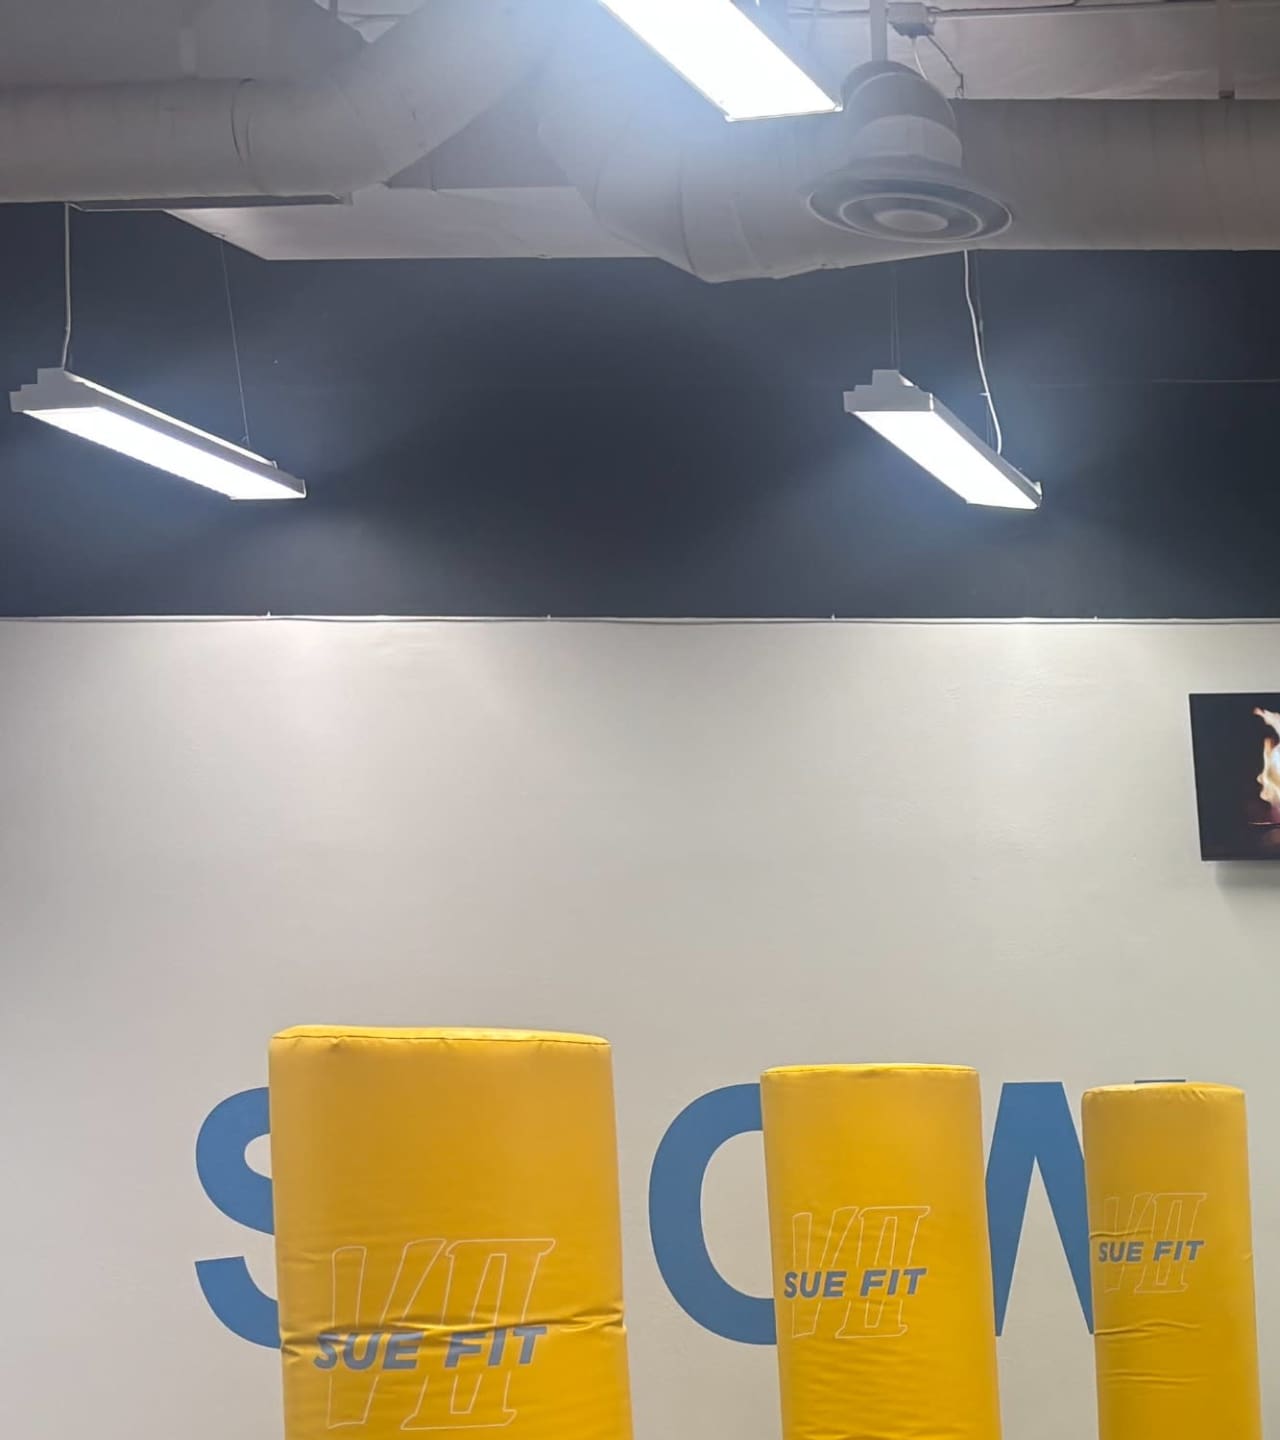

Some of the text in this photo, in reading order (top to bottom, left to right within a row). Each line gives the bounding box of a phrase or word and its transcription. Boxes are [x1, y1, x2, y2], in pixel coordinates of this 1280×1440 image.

[1098, 1239, 1205, 1262] SUE FIT
[783, 1267, 927, 1299] SUE FIT
[314, 1325, 547, 1371] SUE FIT
